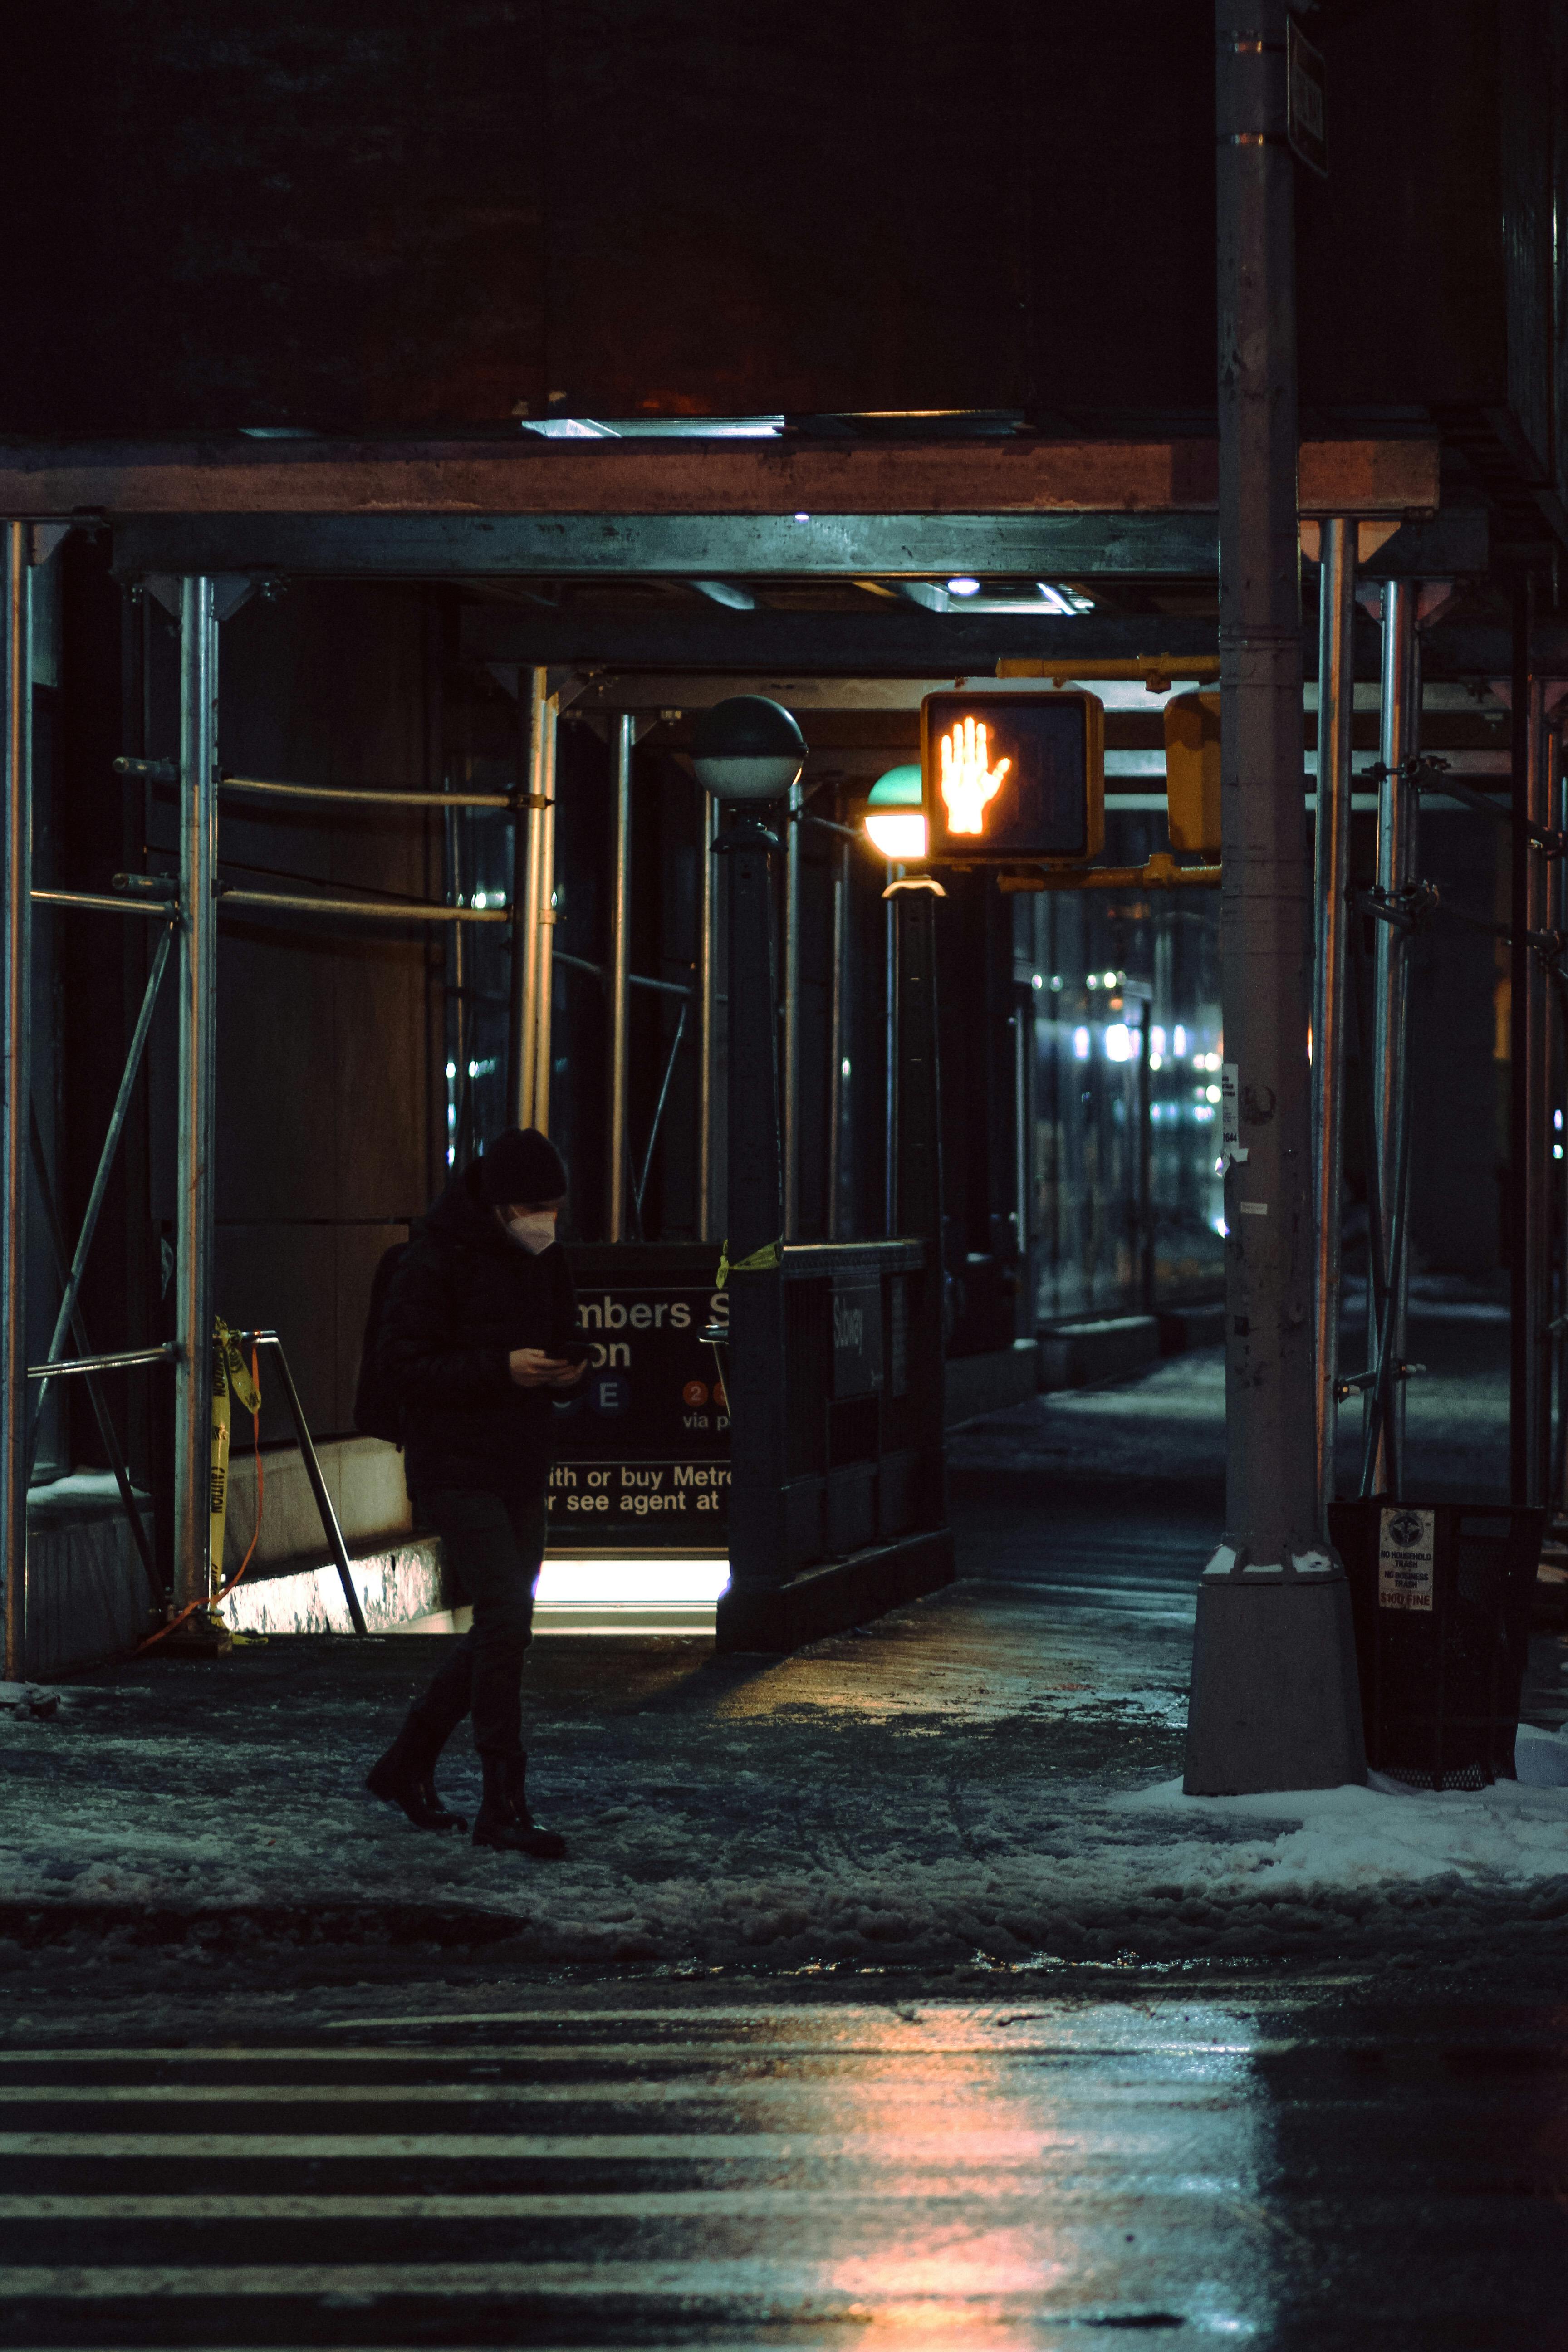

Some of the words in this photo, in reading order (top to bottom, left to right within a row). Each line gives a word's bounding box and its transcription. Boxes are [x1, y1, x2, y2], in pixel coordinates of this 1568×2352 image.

[599, 1382, 619, 1407] E
[690, 1386, 701, 1401] 2
[683, 1412, 709, 1429] via
[587, 1470, 611, 1486] or
[621, 1466, 663, 1490] buy
[566, 1495, 609, 1511] see
[619, 1490, 686, 1515] agent
[696, 1490, 719, 1510] at
[1391, 1552, 1431, 1561] HOUSEHOLD
[1395, 1560, 1417, 1568] TRASH
[1395, 1572, 1428, 1581] BUSINESS
[1395, 1580, 1417, 1588] TRASH
[1381, 1592, 1405, 1605] $100
[1407, 1594, 1431, 1606] FINE
